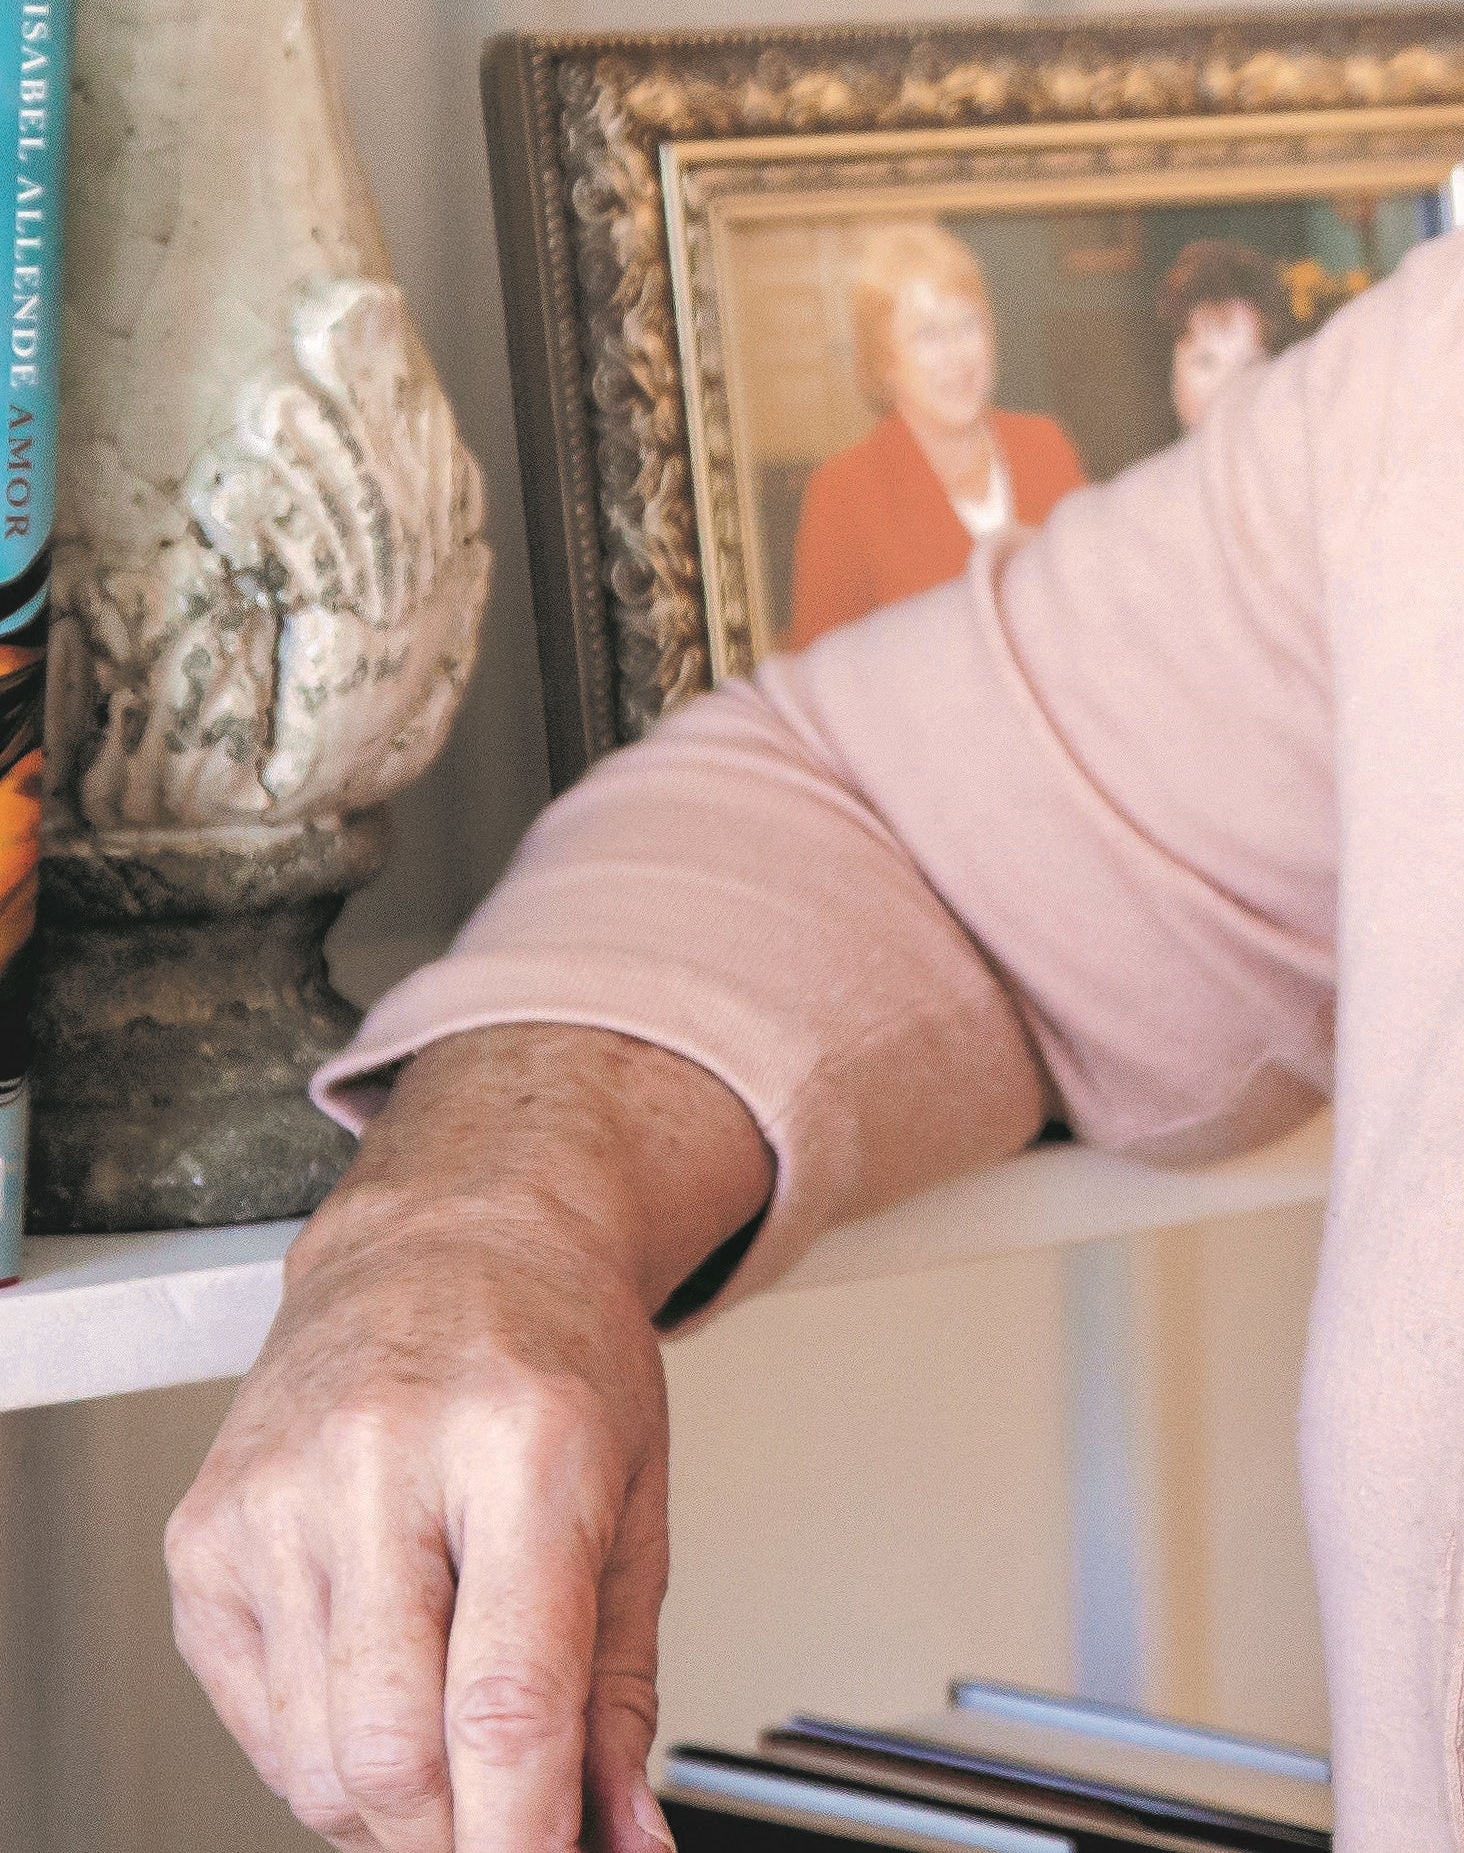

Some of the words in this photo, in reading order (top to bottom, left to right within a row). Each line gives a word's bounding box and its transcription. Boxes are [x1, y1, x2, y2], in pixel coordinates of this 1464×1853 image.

[16, 2, 52, 162] ISABEL
[10, 176, 46, 389] ALLENDE
[4, 403, 35, 541] AMOR
